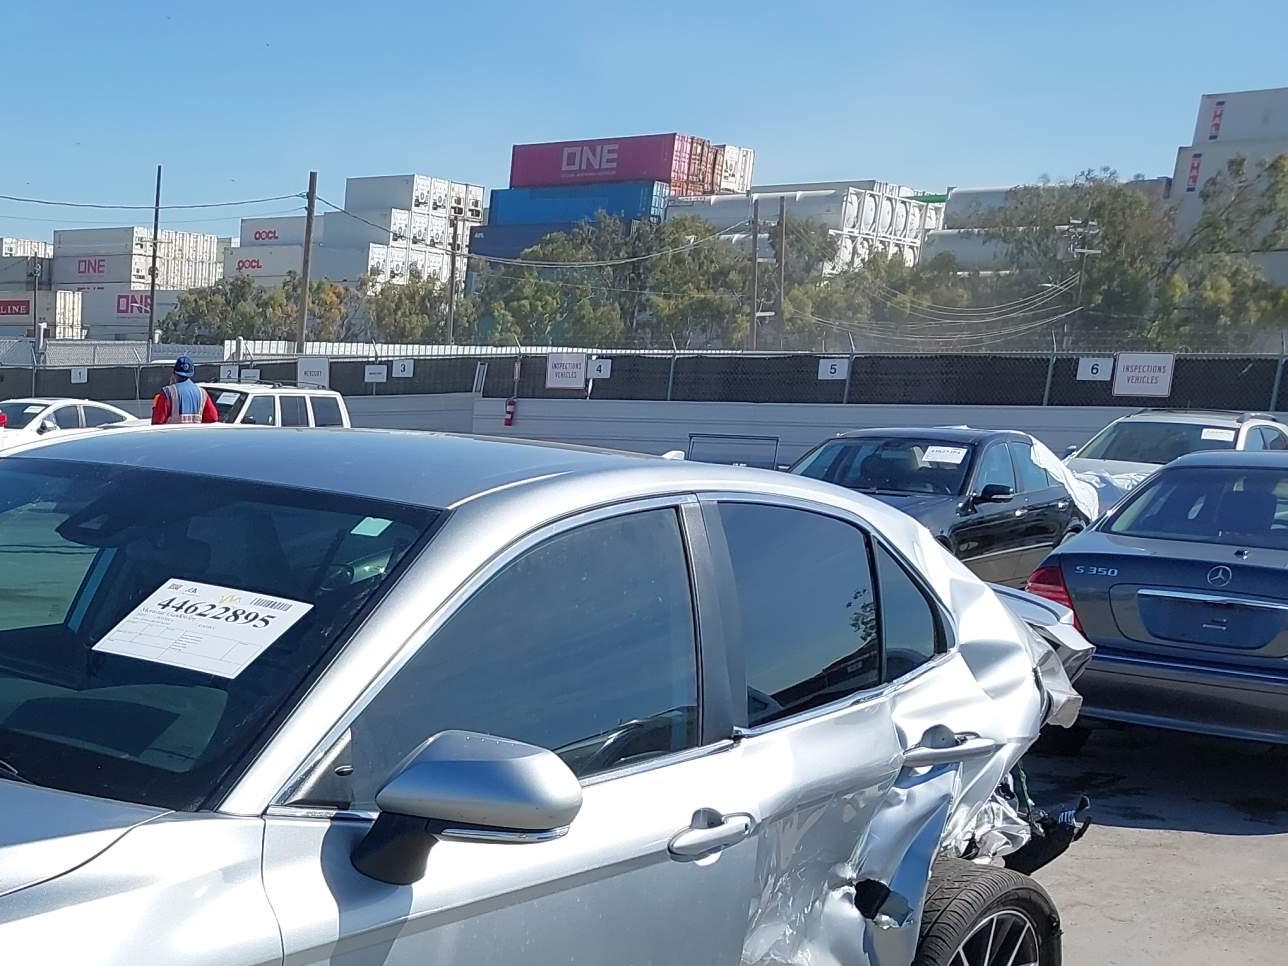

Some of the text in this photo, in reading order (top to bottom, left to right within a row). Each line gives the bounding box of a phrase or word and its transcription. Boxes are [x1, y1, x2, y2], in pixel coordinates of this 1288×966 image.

[562, 144, 619, 170] ONE
[254, 230, 279, 240] OOCL
[77, 259, 105, 274] ONE
[237, 259, 262, 269] OOCL
[400, 363, 406, 373] 3
[595, 364, 602, 374] 4
[829, 363, 838, 375] 5
[1090, 363, 1100, 375] 6
[1122, 364, 1167, 374] INSPECTIONS
[78, 371, 82, 379] 1
[226, 369, 232, 378] 2
[1127, 375, 1159, 385] VEHICLES
[1075, 565, 1118, 576] S 350
[158, 597, 276, 629] 44622895
